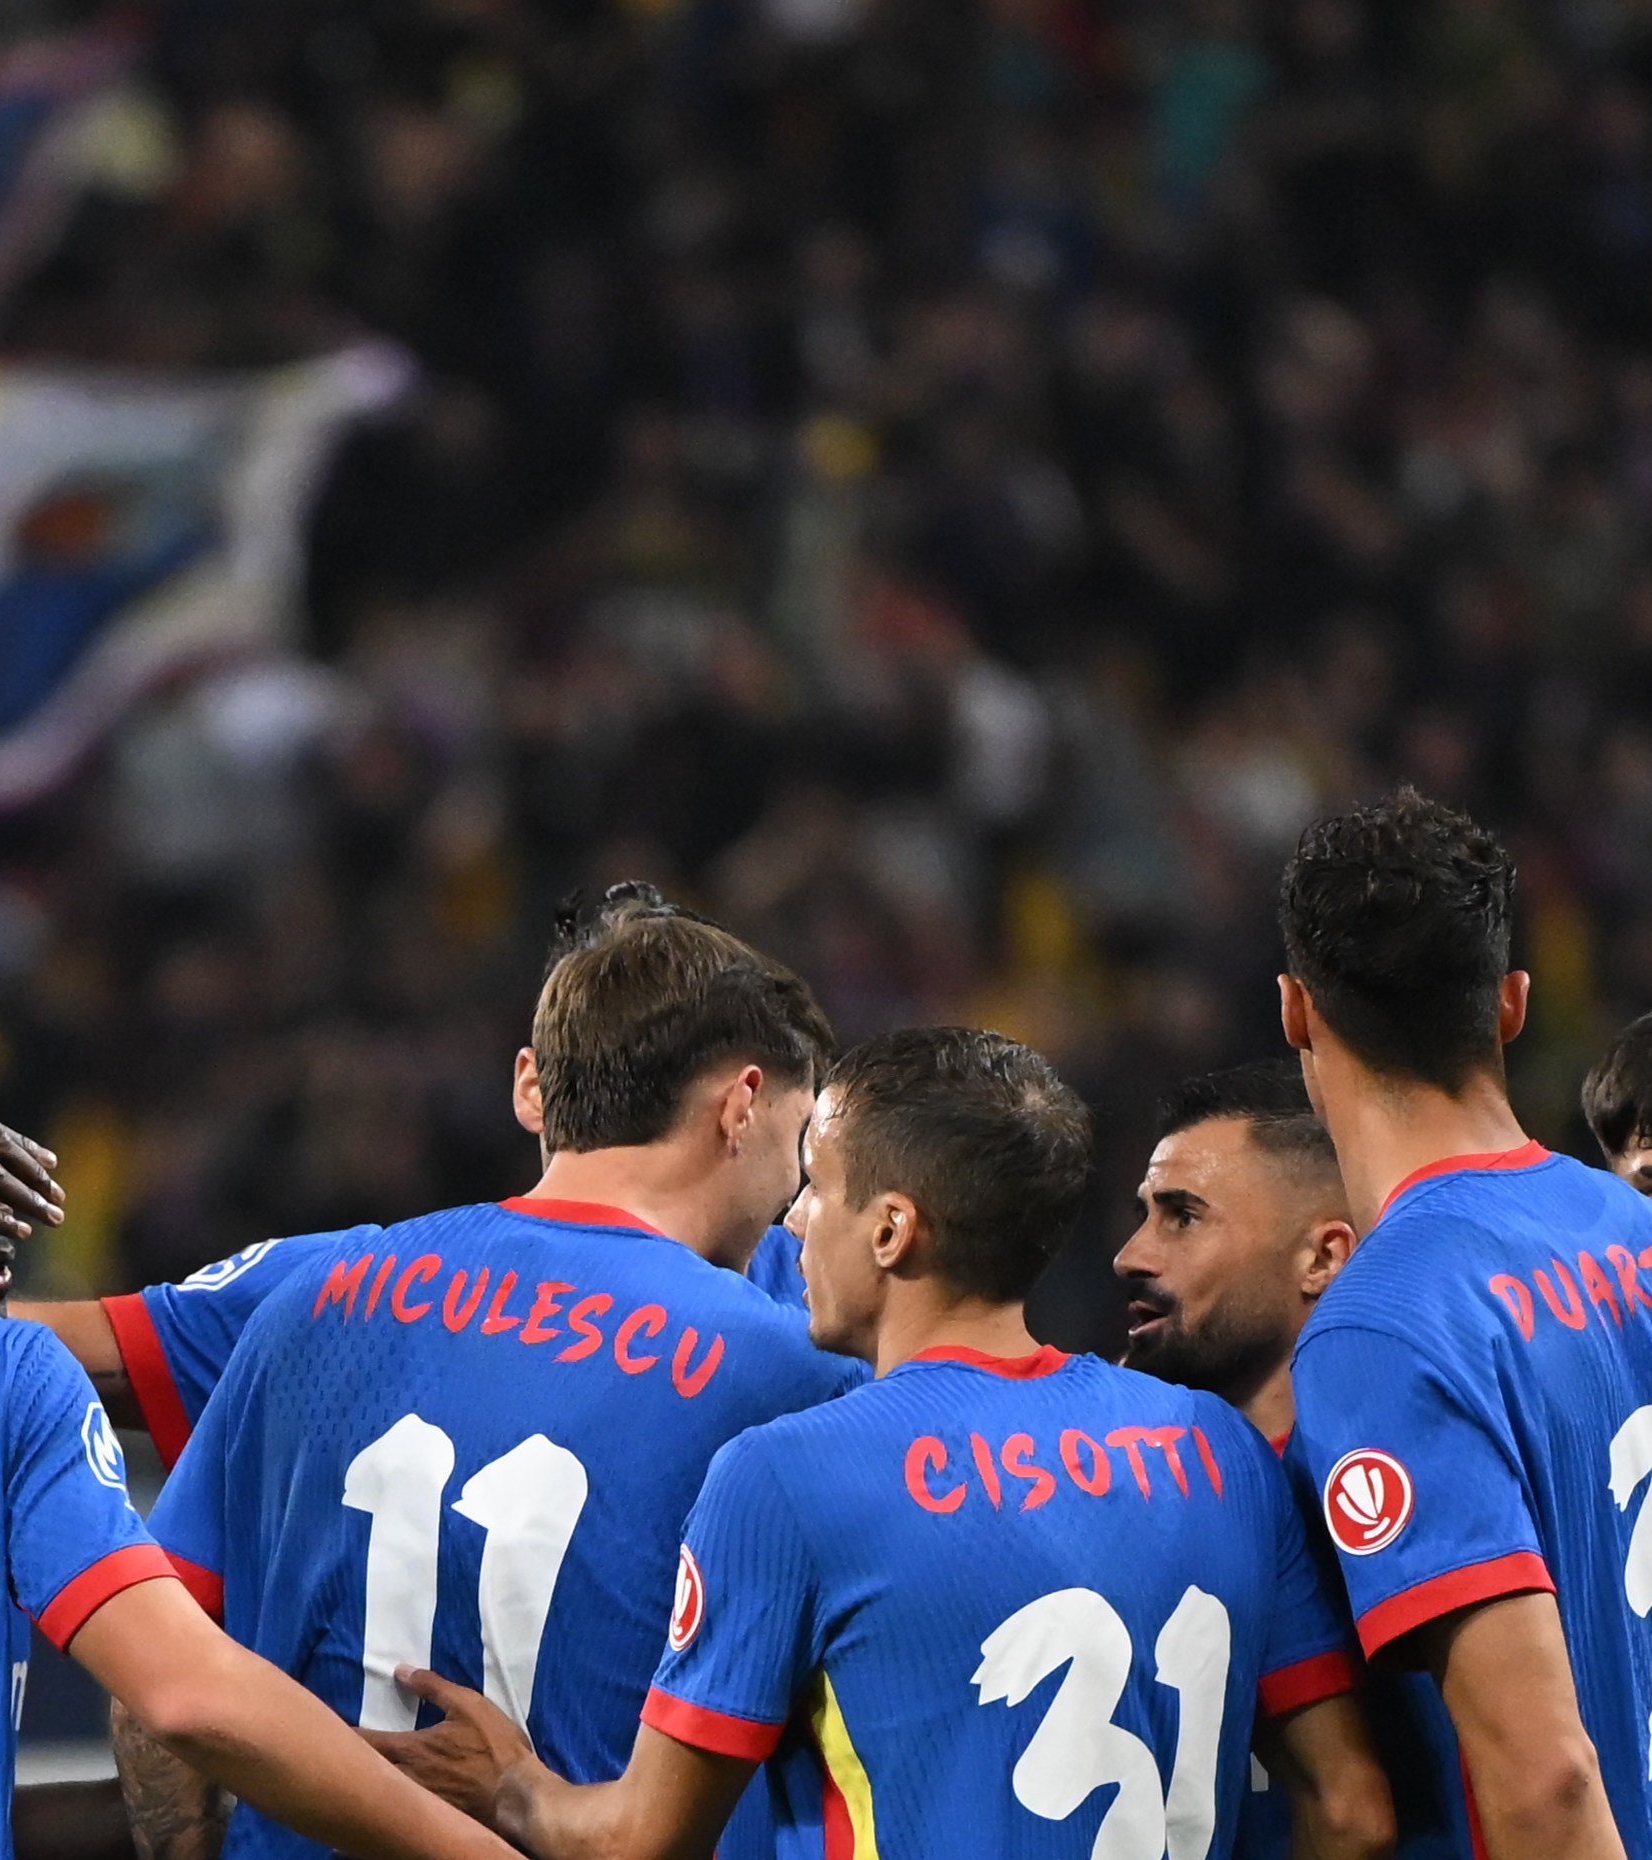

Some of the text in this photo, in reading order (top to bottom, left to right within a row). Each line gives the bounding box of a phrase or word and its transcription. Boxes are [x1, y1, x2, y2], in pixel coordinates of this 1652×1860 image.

[314, 1253, 724, 1398] MICULESCU
[904, 1426, 1223, 1514] CISOTTI
[341, 1412, 589, 1754] 11
